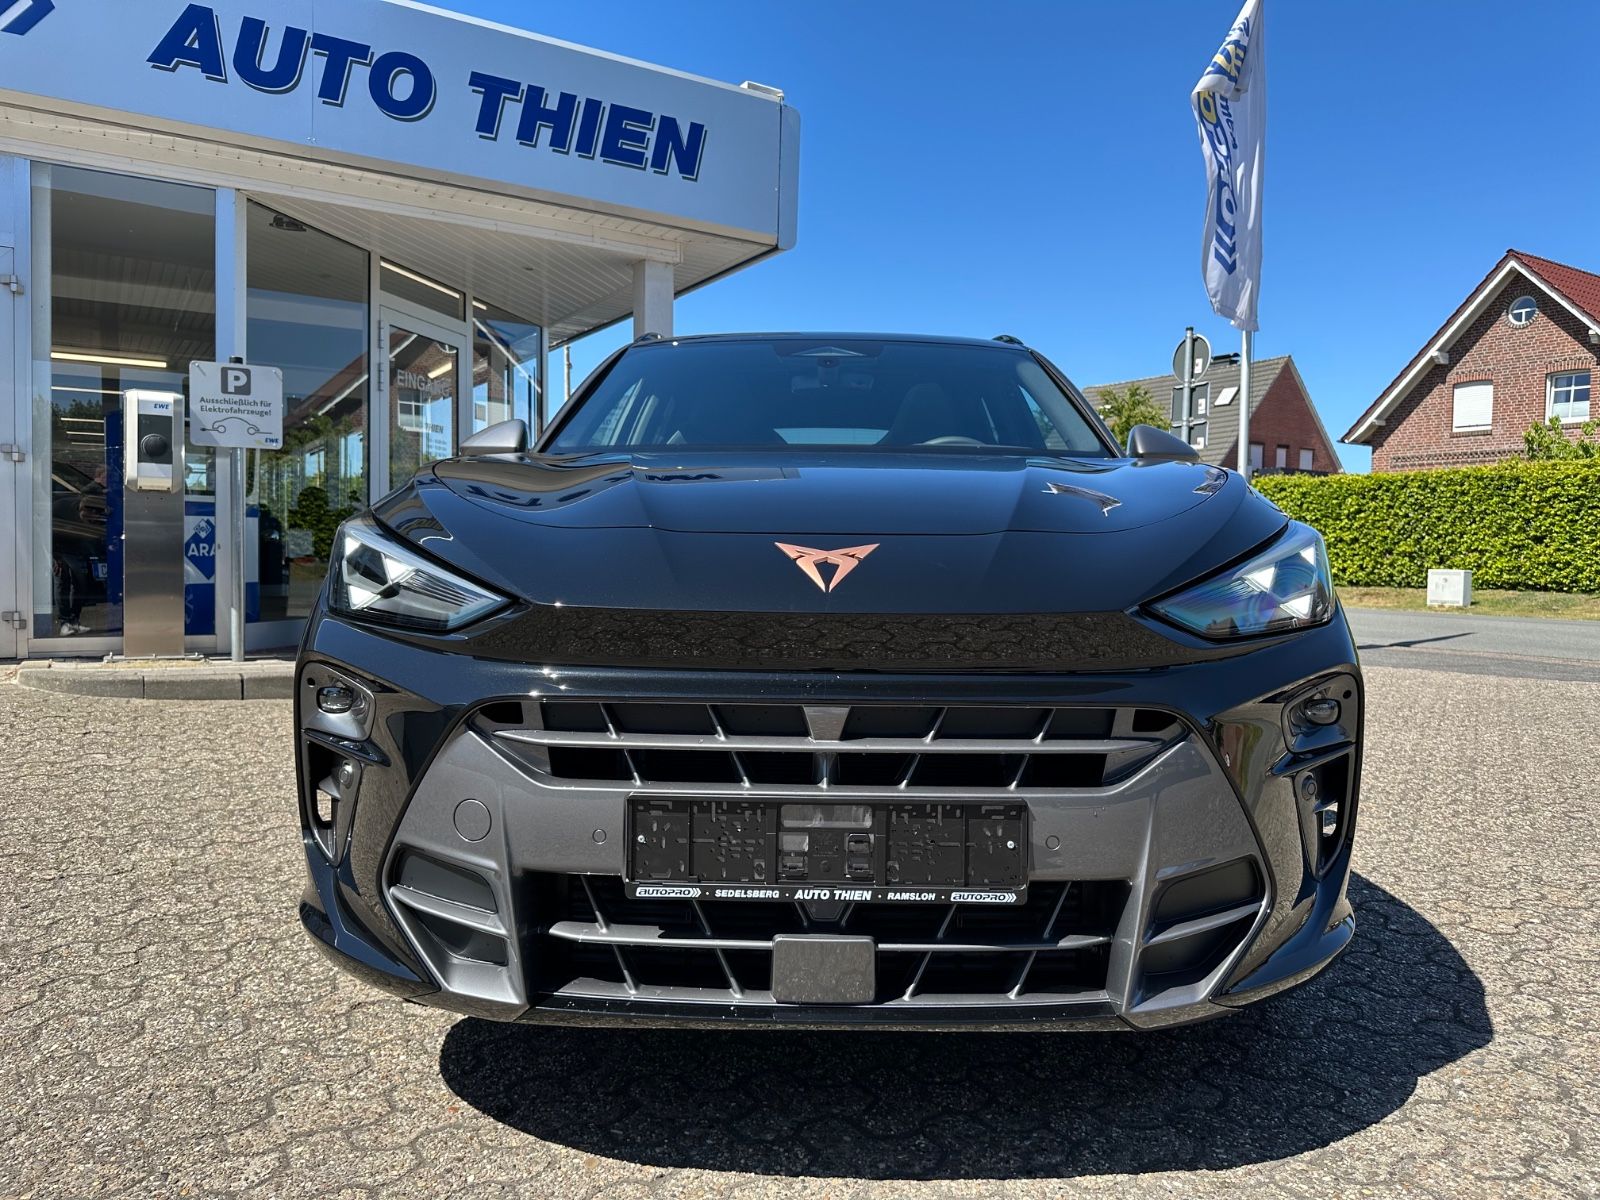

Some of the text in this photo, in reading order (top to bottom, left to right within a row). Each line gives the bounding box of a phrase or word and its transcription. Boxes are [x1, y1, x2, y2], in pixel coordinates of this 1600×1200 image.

[146, 3, 708, 181] AUTO THIEN
[227, 369, 248, 393] P
[199, 396, 272, 408] Ausschließlich für
[200, 405, 272, 417] Elektrofahrzeuge!
[187, 543, 216, 557] ARA
[714, 889, 780, 898] SEDELSBERG
[794, 889, 831, 900] AUTO
[833, 890, 872, 901] THIEN
[887, 892, 936, 901] RAMSLOH
